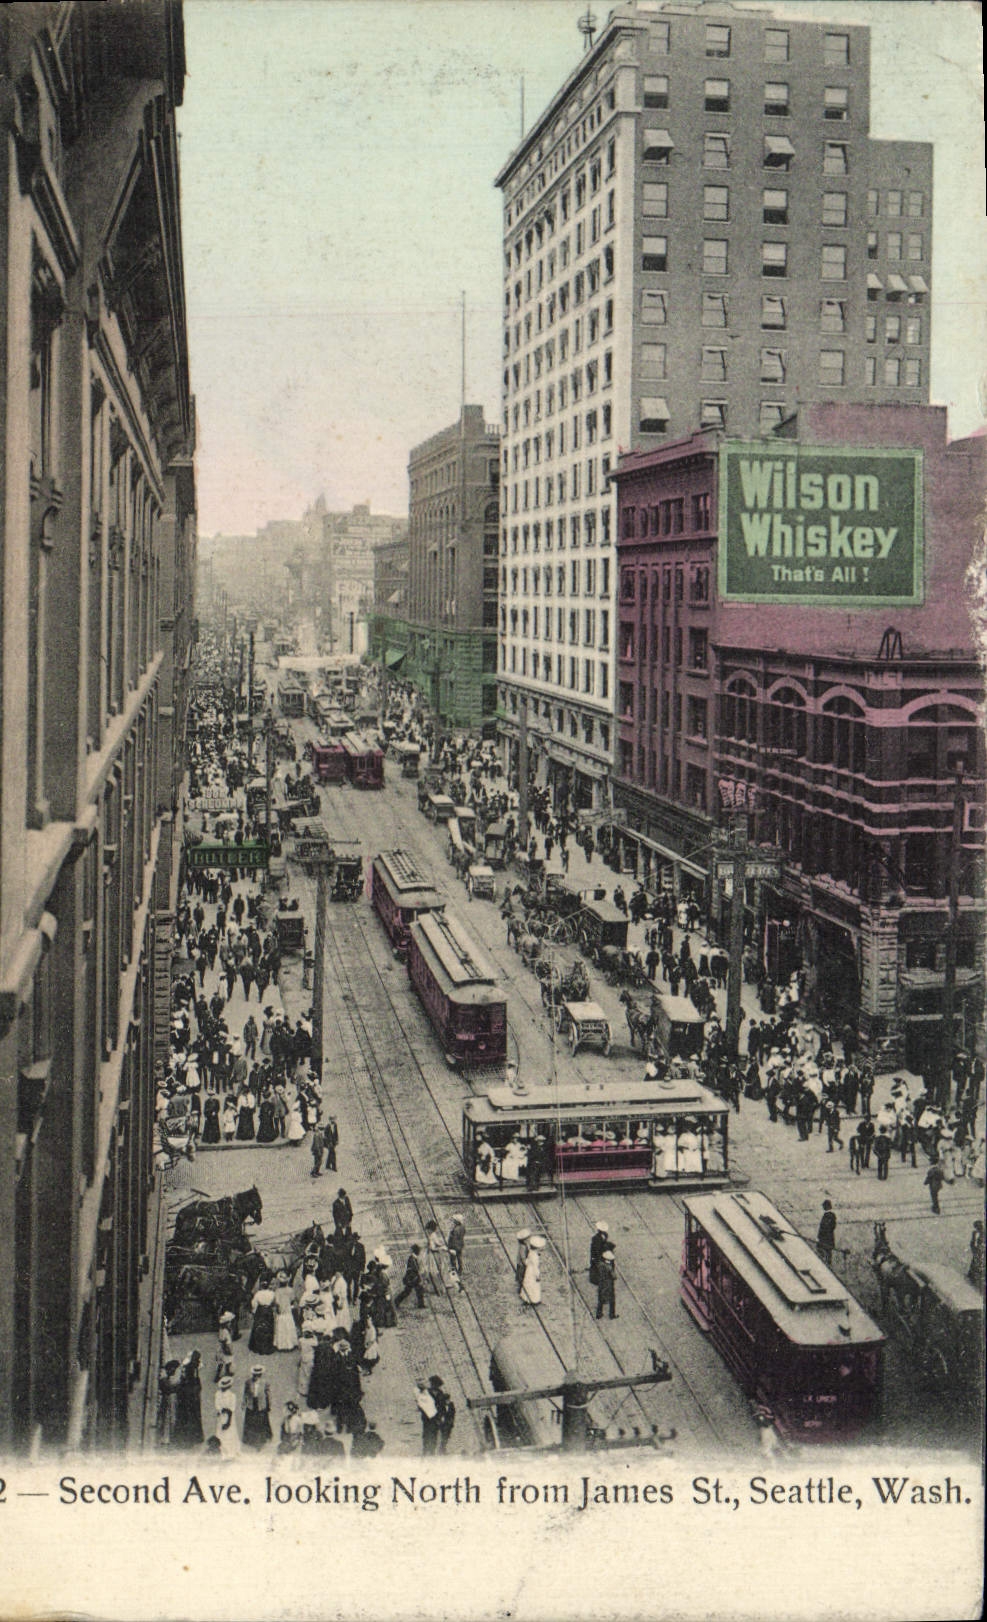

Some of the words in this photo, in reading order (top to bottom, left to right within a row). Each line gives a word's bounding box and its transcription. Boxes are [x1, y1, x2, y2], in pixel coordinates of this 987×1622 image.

[739, 459, 880, 512] Wilson
[740, 512, 899, 560] Whiskey
[771, 564, 826, 583] That's
